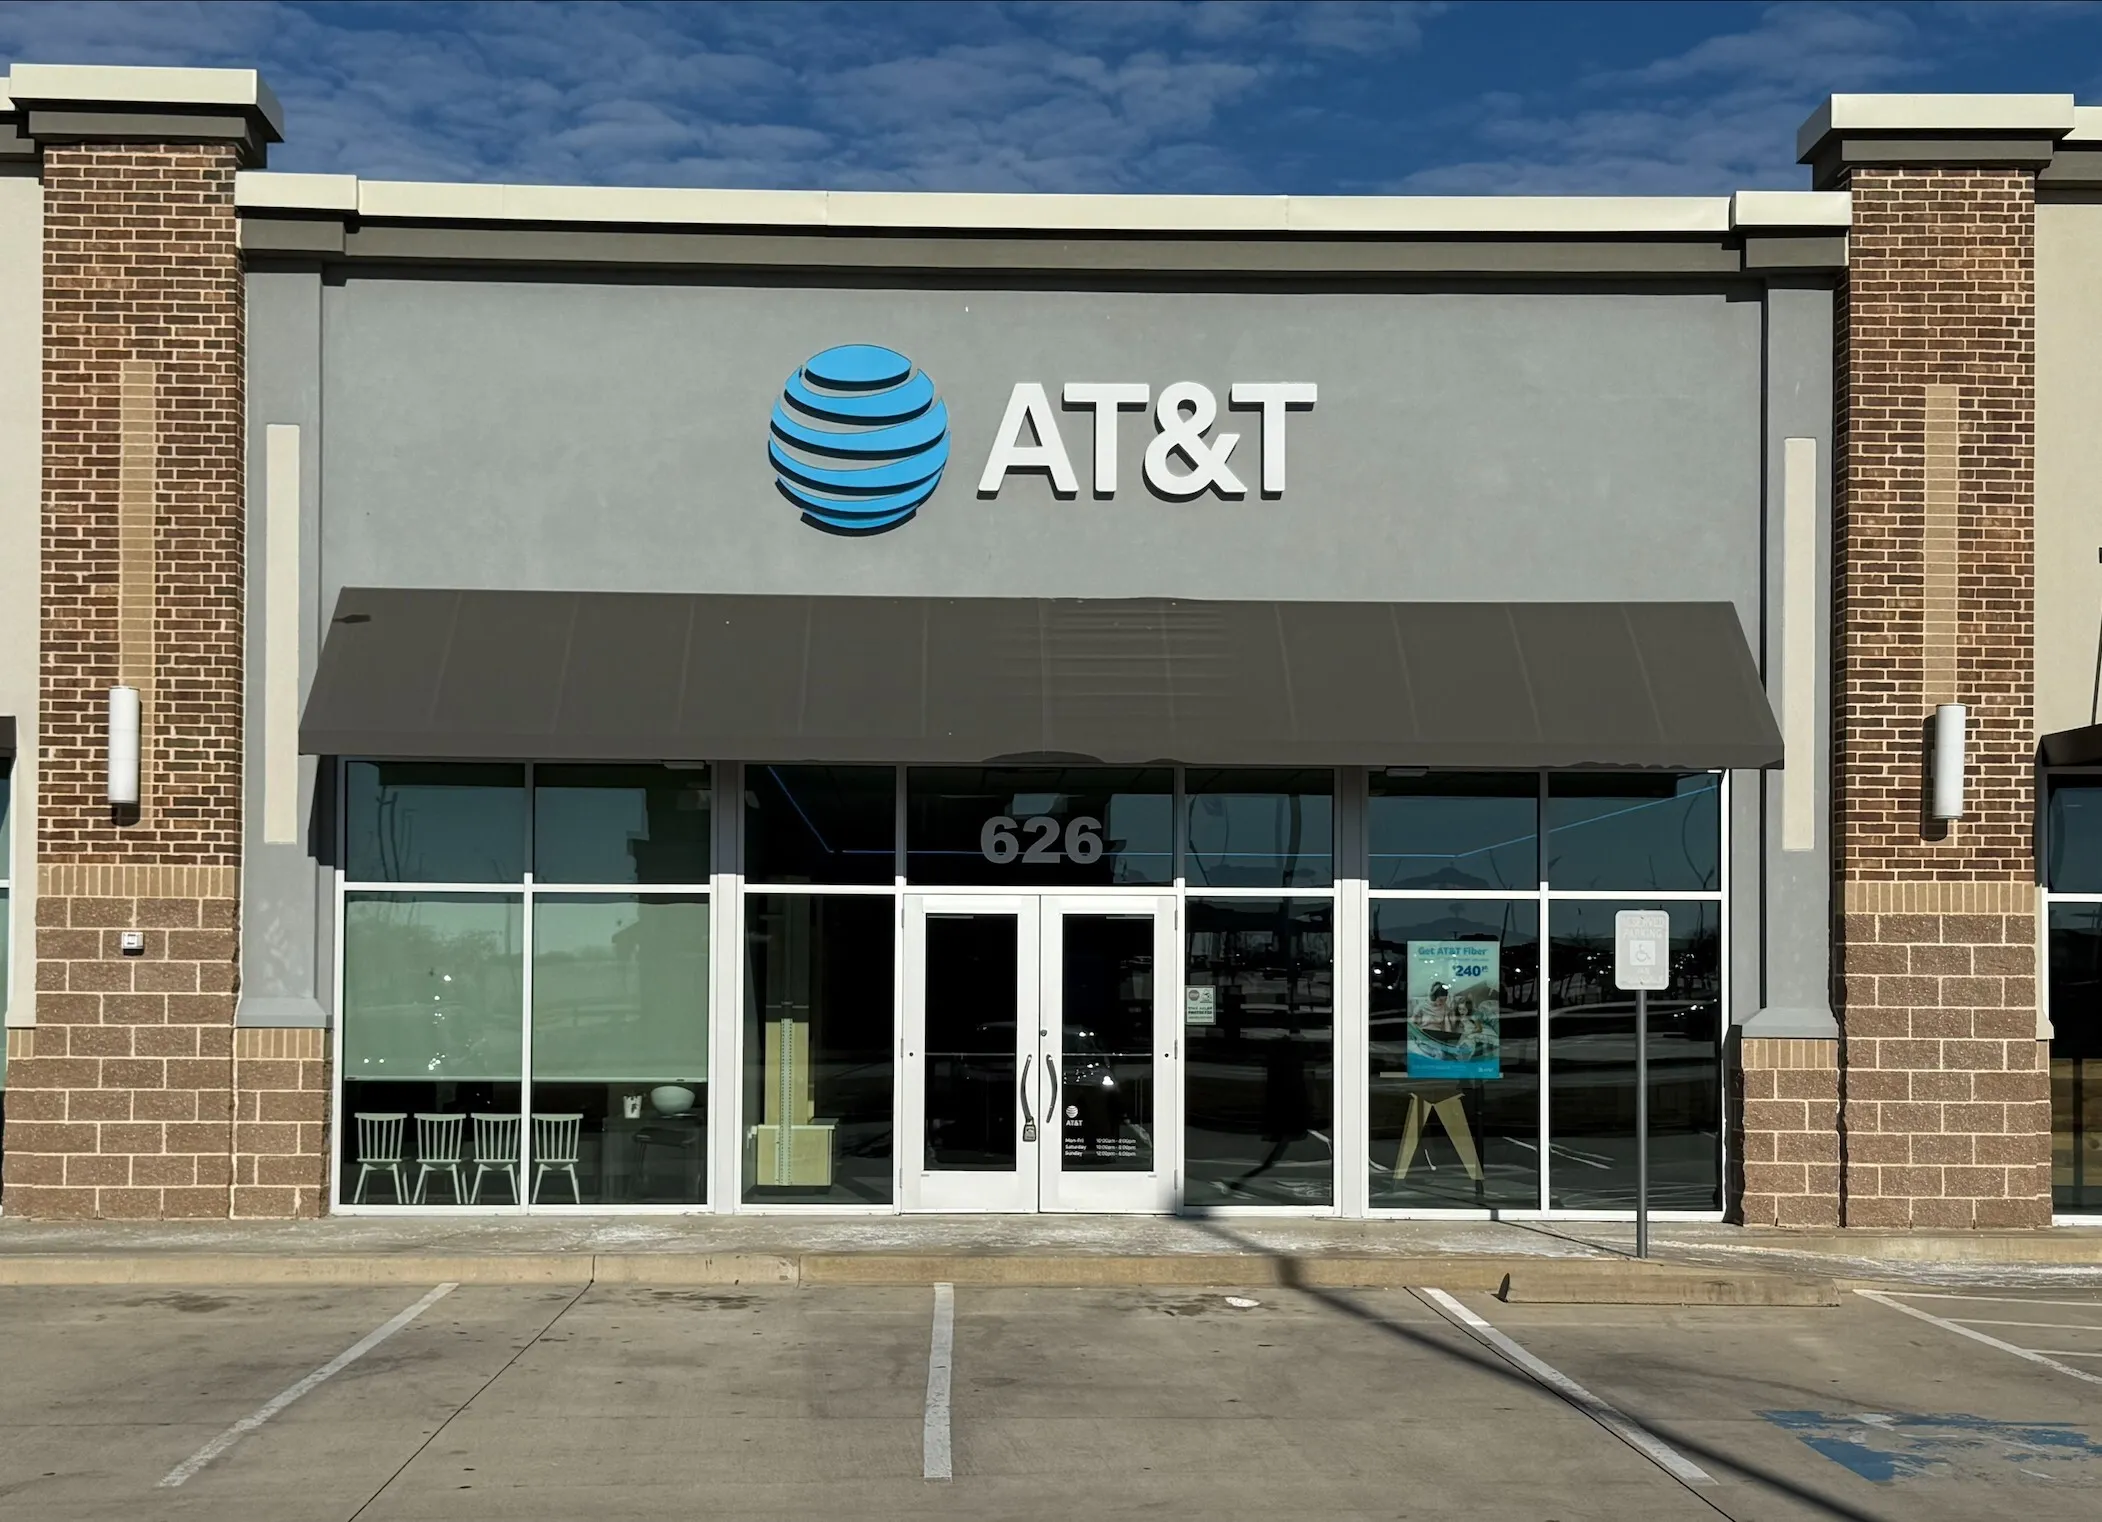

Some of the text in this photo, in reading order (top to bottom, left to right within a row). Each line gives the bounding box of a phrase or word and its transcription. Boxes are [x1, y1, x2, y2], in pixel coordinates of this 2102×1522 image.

[977, 381, 1318, 497] AT&T
[980, 815, 1103, 865] 626
[1418, 946, 1488, 956] Get AT&T Fiber
[1065, 1119, 1083, 1127] AT&T
